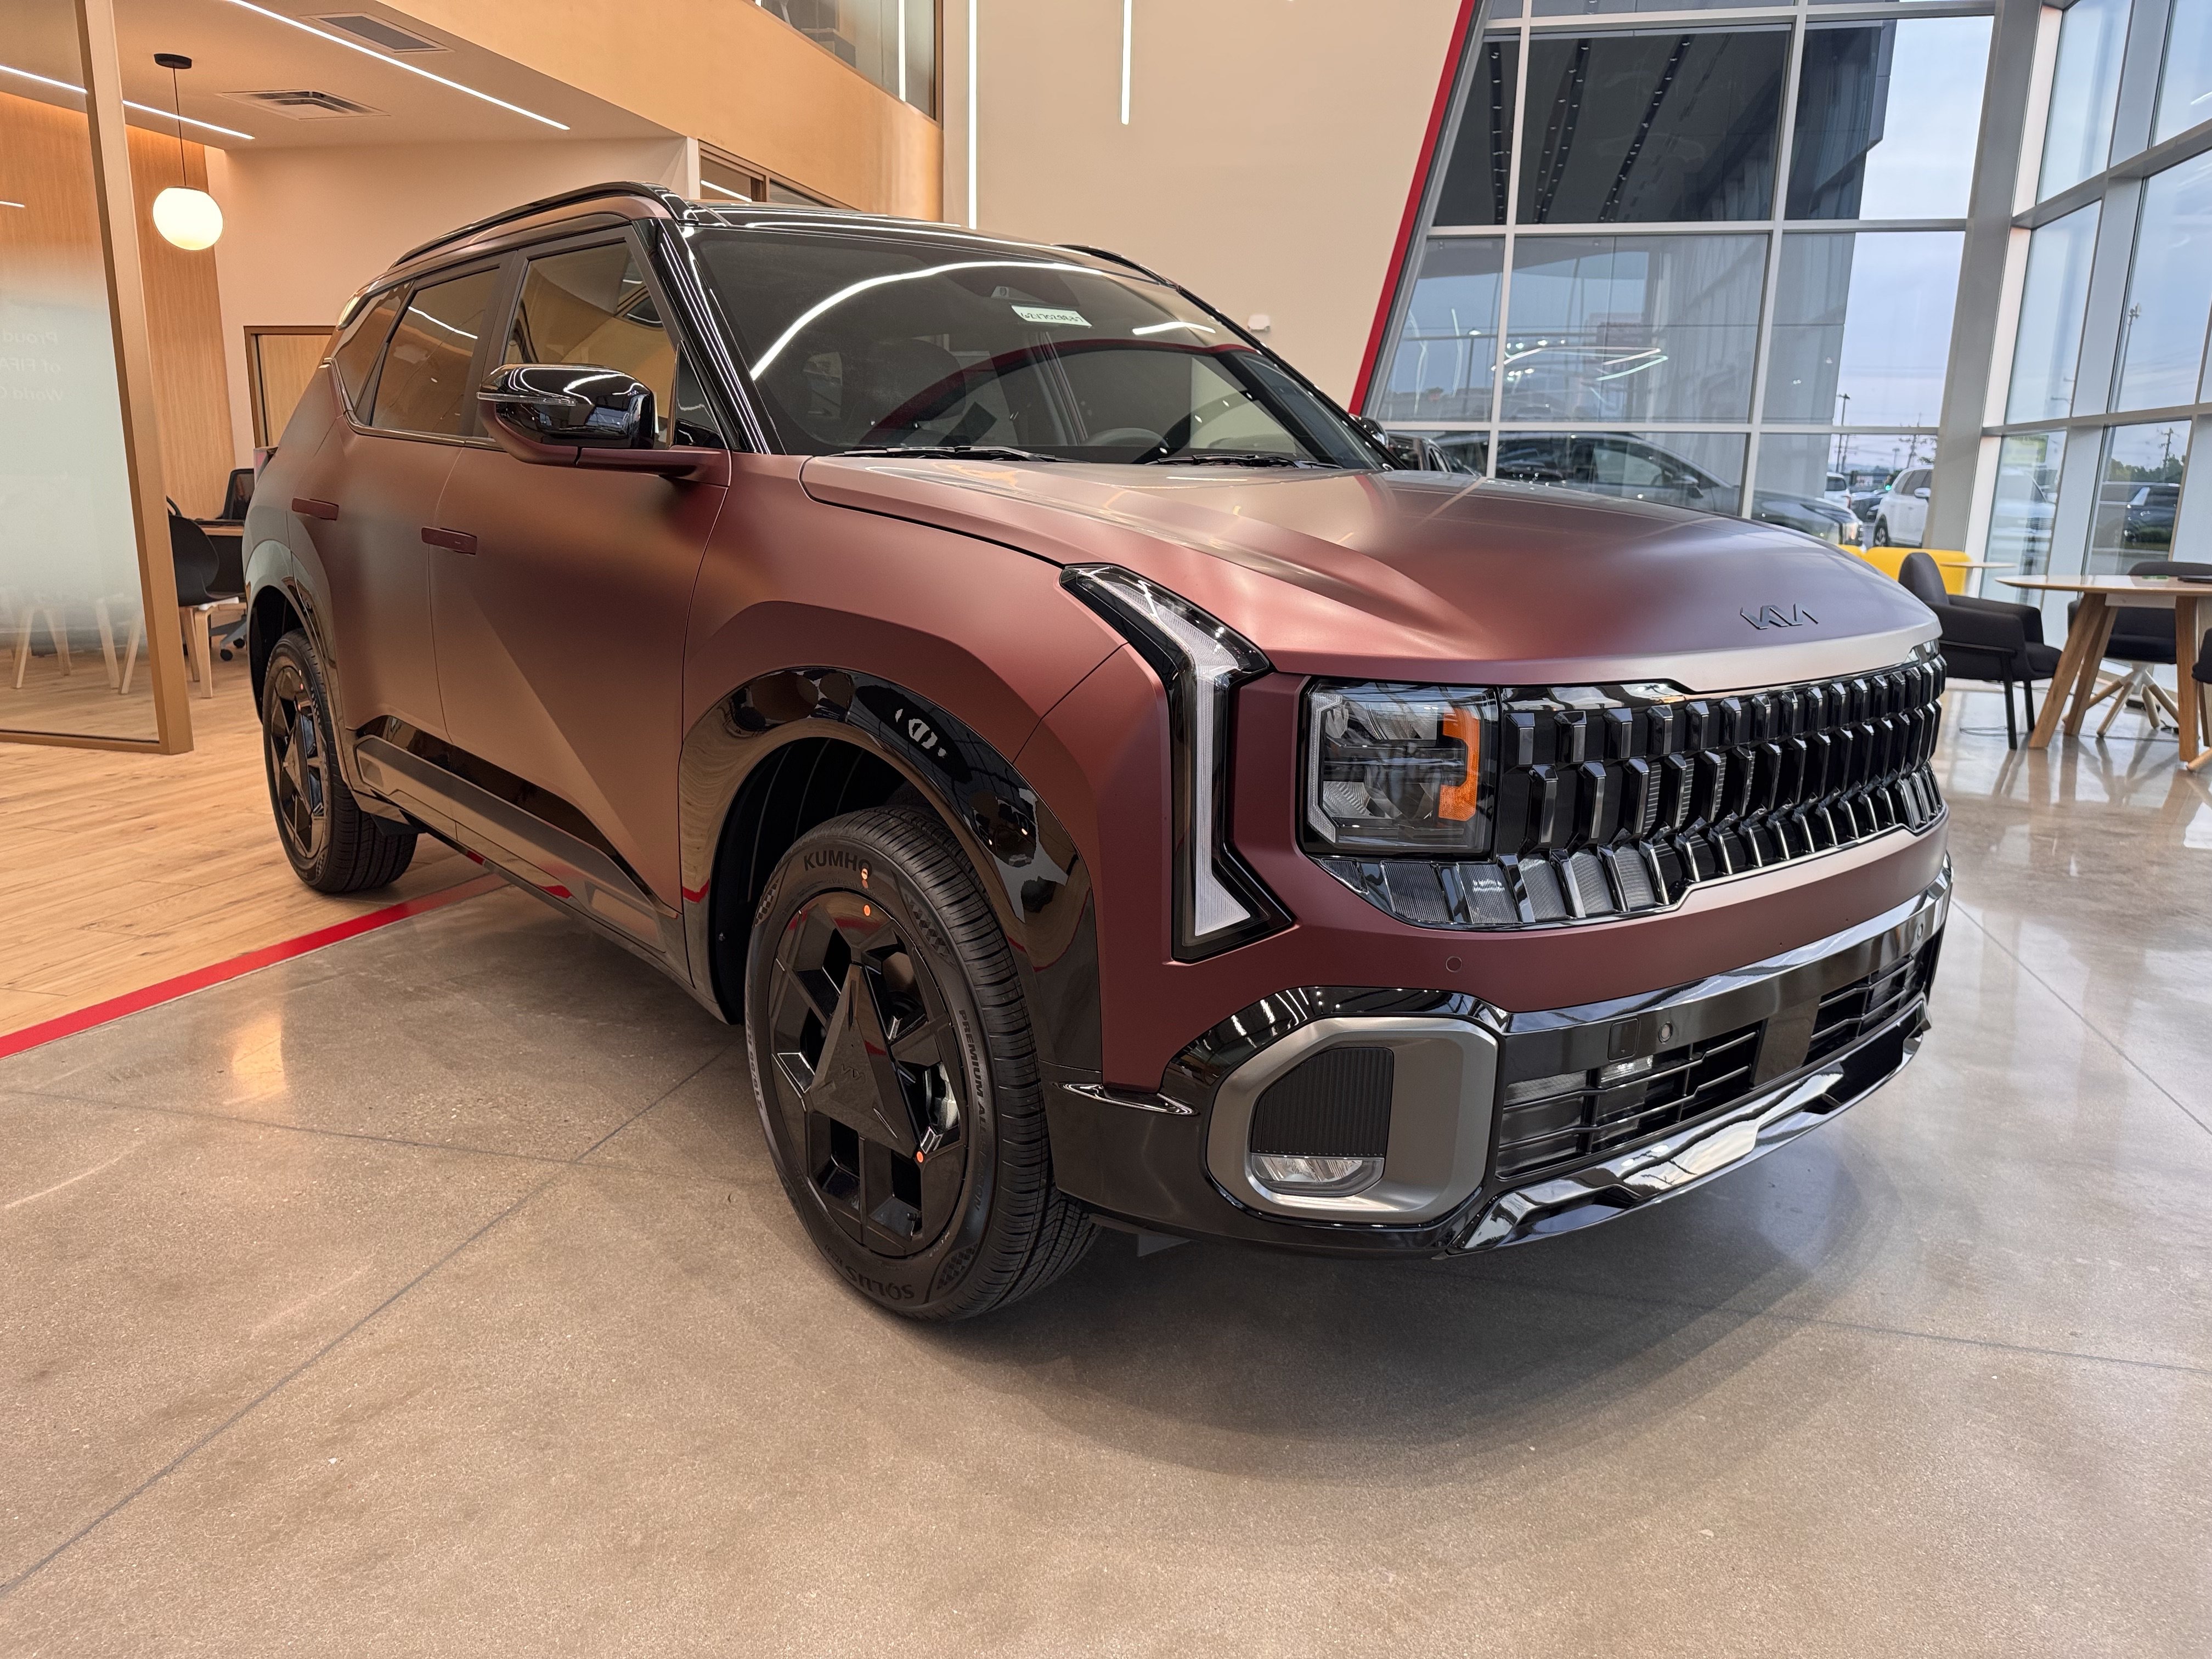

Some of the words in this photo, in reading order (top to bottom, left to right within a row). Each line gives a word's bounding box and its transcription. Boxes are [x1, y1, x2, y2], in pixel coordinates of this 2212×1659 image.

[803, 850, 873, 878] KUMHO
[958, 1009, 984, 1097] PREMIUM
[845, 1266, 915, 1300] SOLUS
